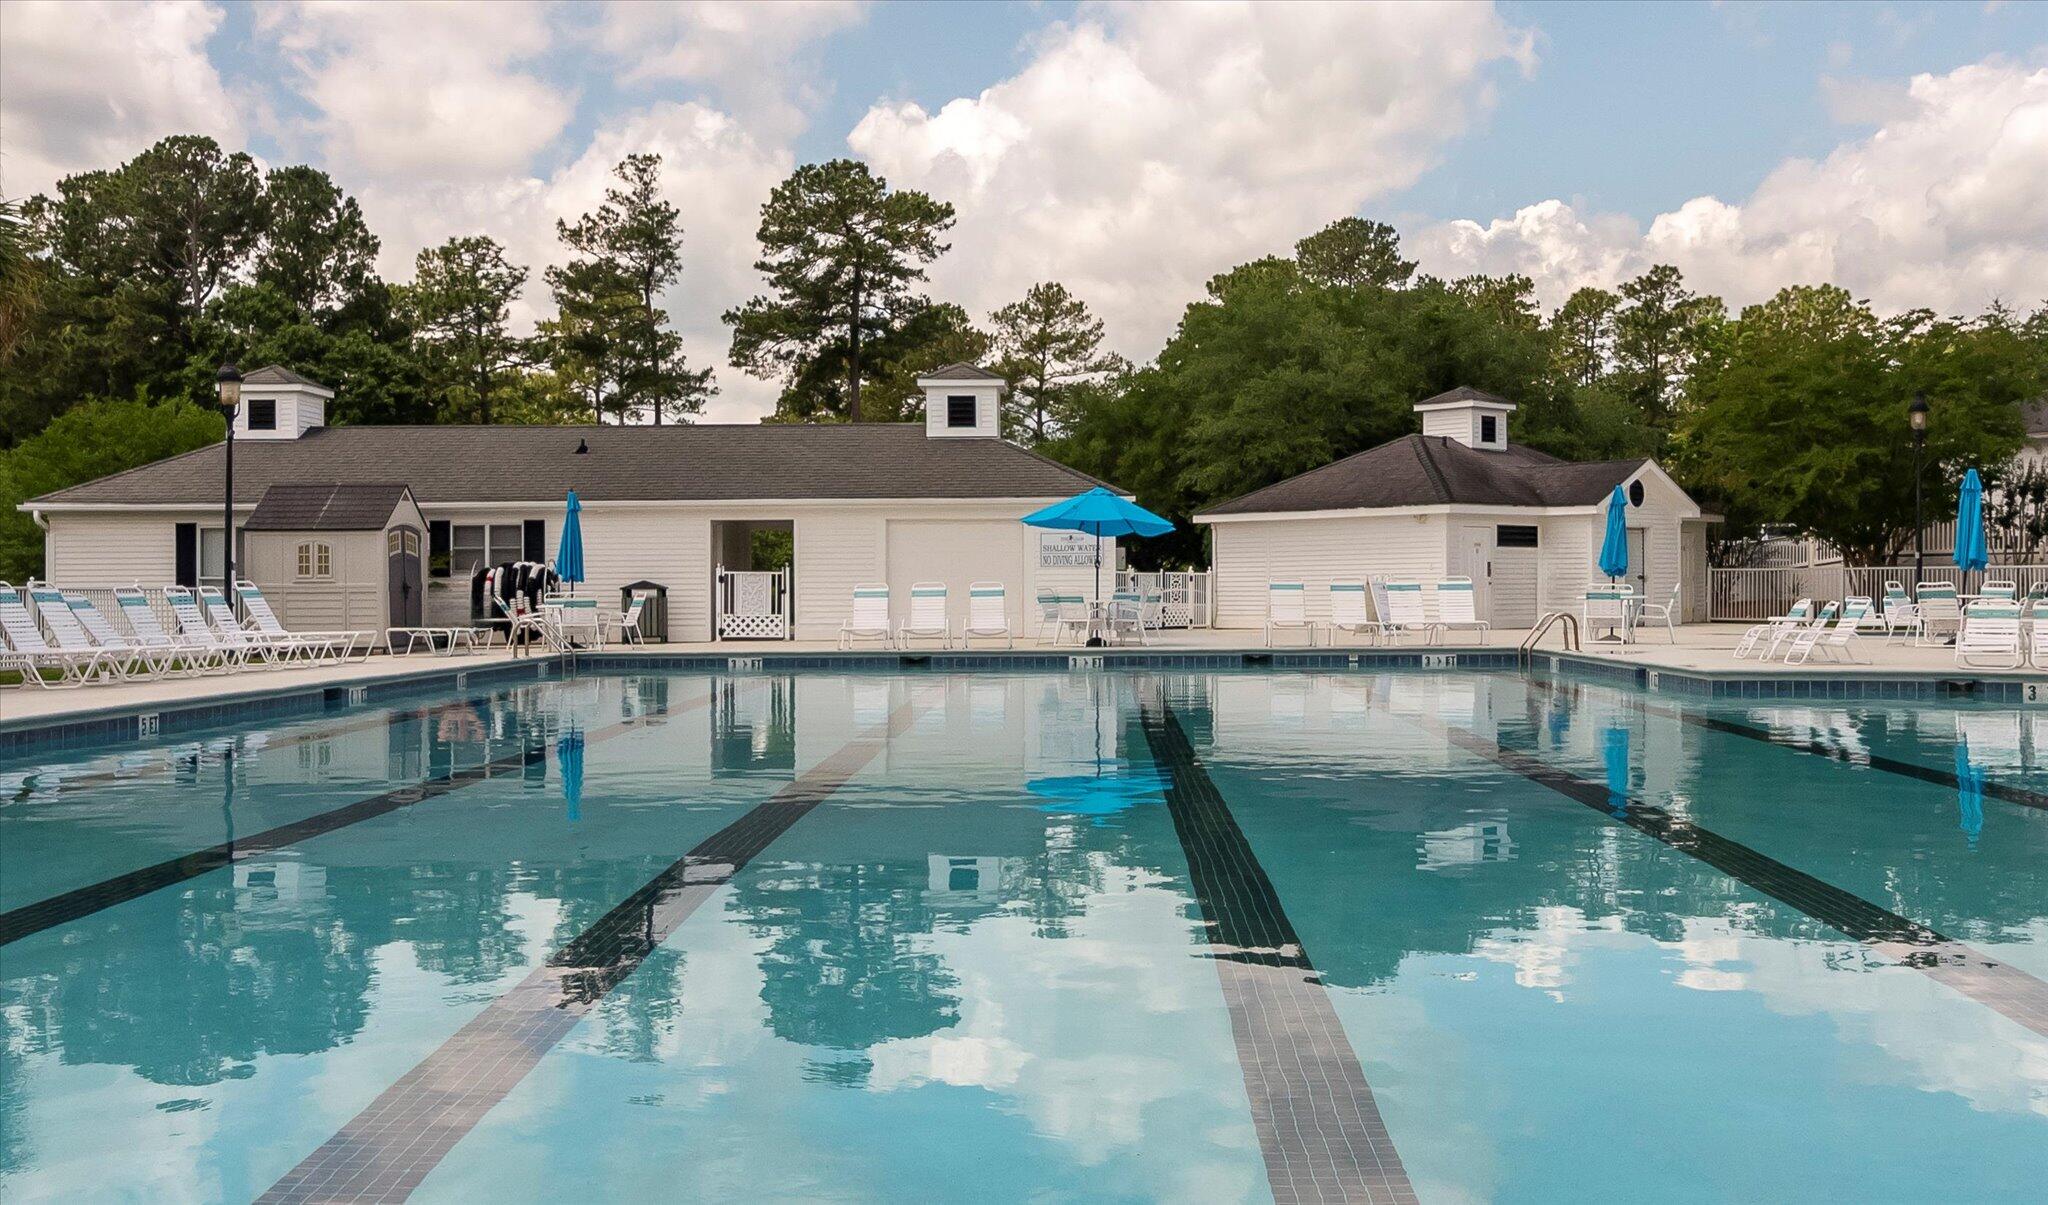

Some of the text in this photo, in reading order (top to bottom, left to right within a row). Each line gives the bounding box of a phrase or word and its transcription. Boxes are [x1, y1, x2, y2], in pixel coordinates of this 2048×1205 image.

[1042, 544, 1076, 552] SHALLOW
[1042, 554, 1052, 566] NO
[1052, 554, 1073, 566] DIVING
[1445, 655, 1456, 667] FT
[2028, 685, 2037, 701] 3
